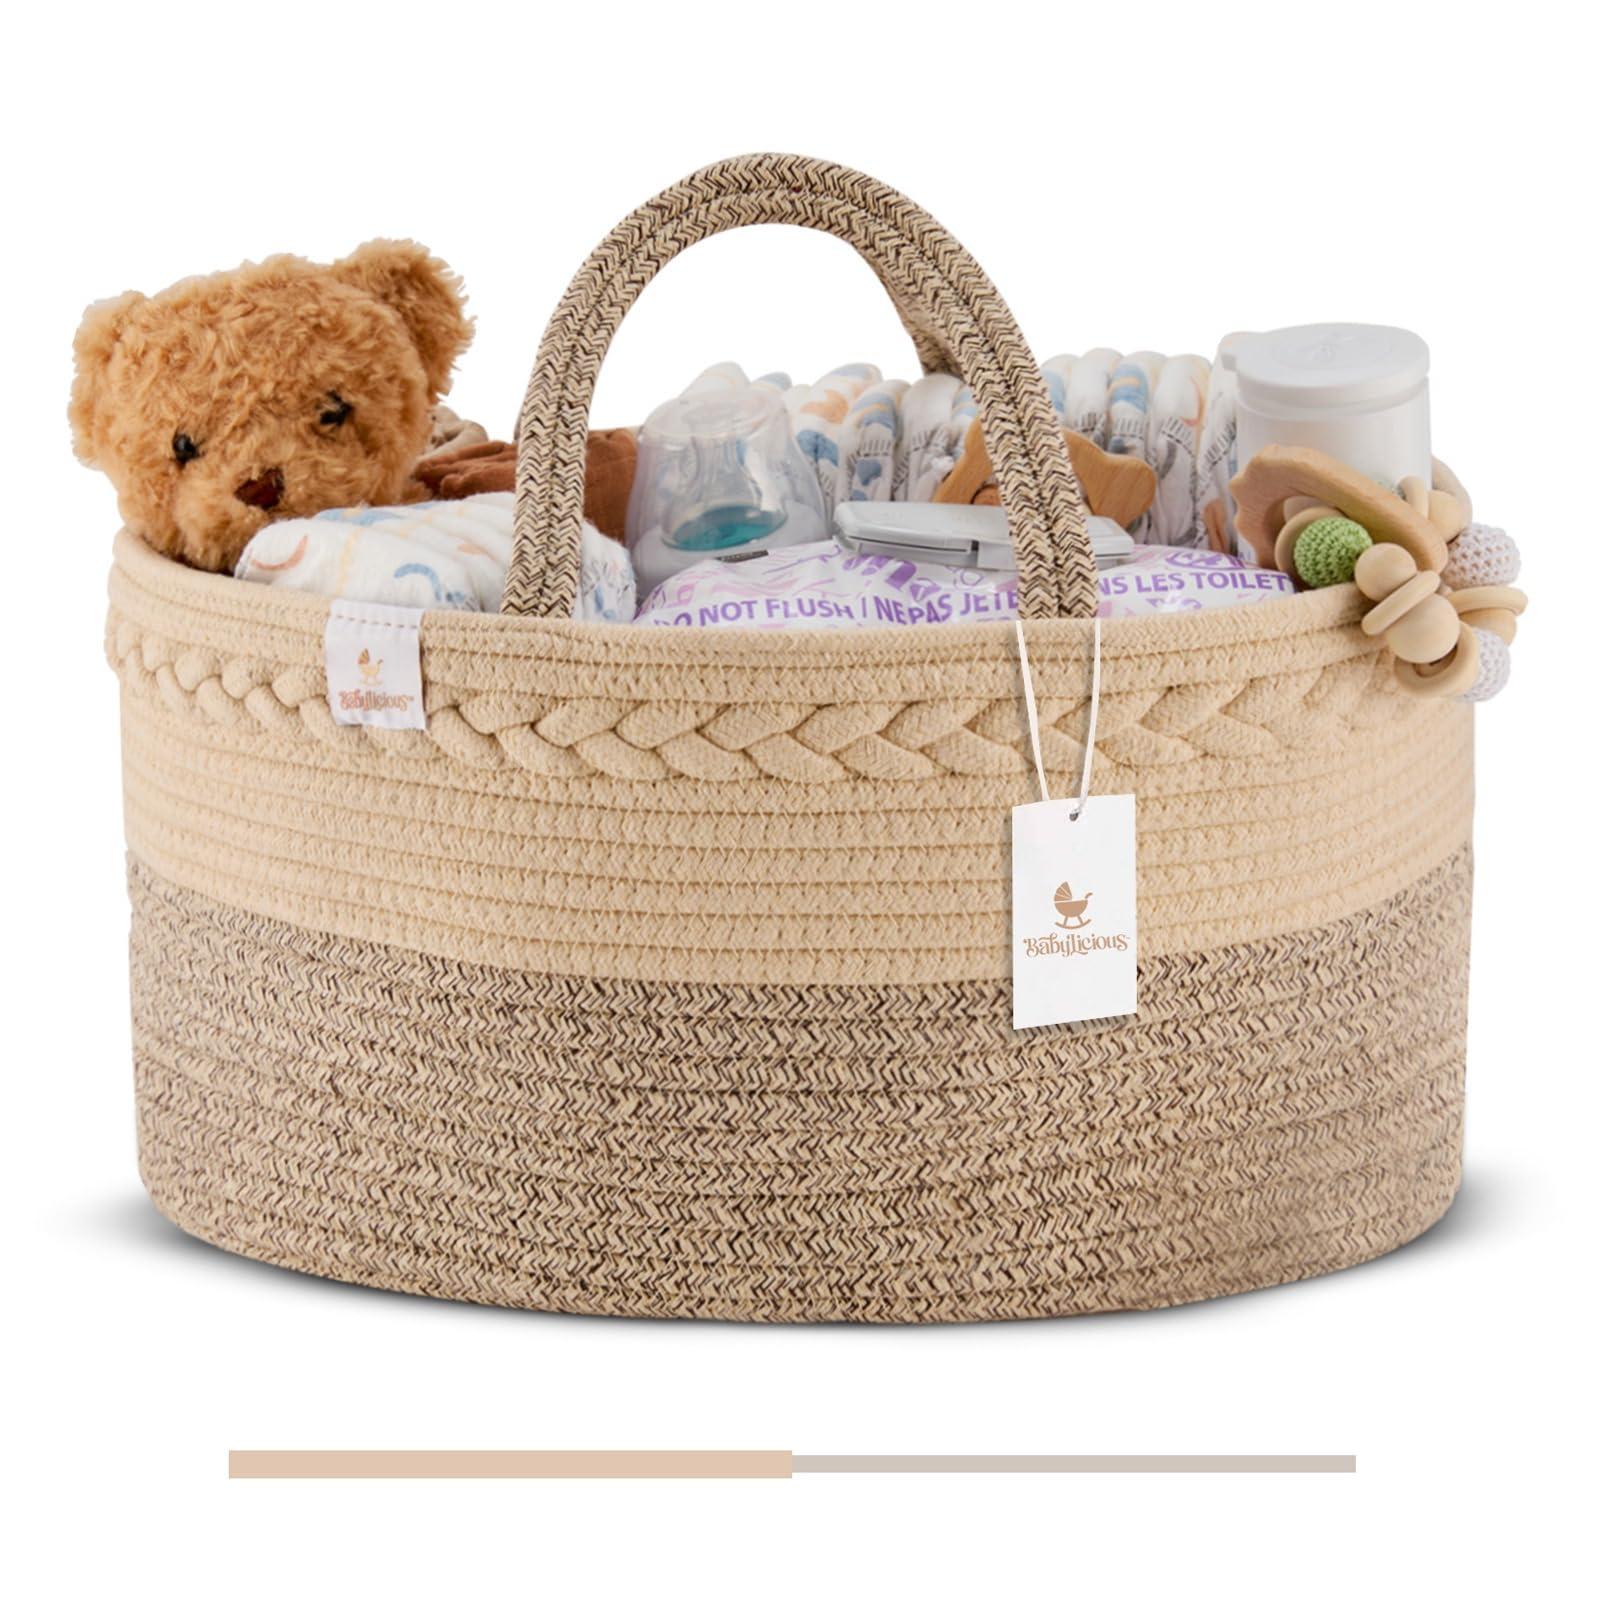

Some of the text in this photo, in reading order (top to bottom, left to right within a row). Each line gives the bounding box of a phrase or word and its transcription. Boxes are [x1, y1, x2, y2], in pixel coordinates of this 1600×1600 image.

[1135, 572, 1186, 593] LES
[699, 600, 758, 627] NOT
[766, 597, 854, 620] FLUSH
